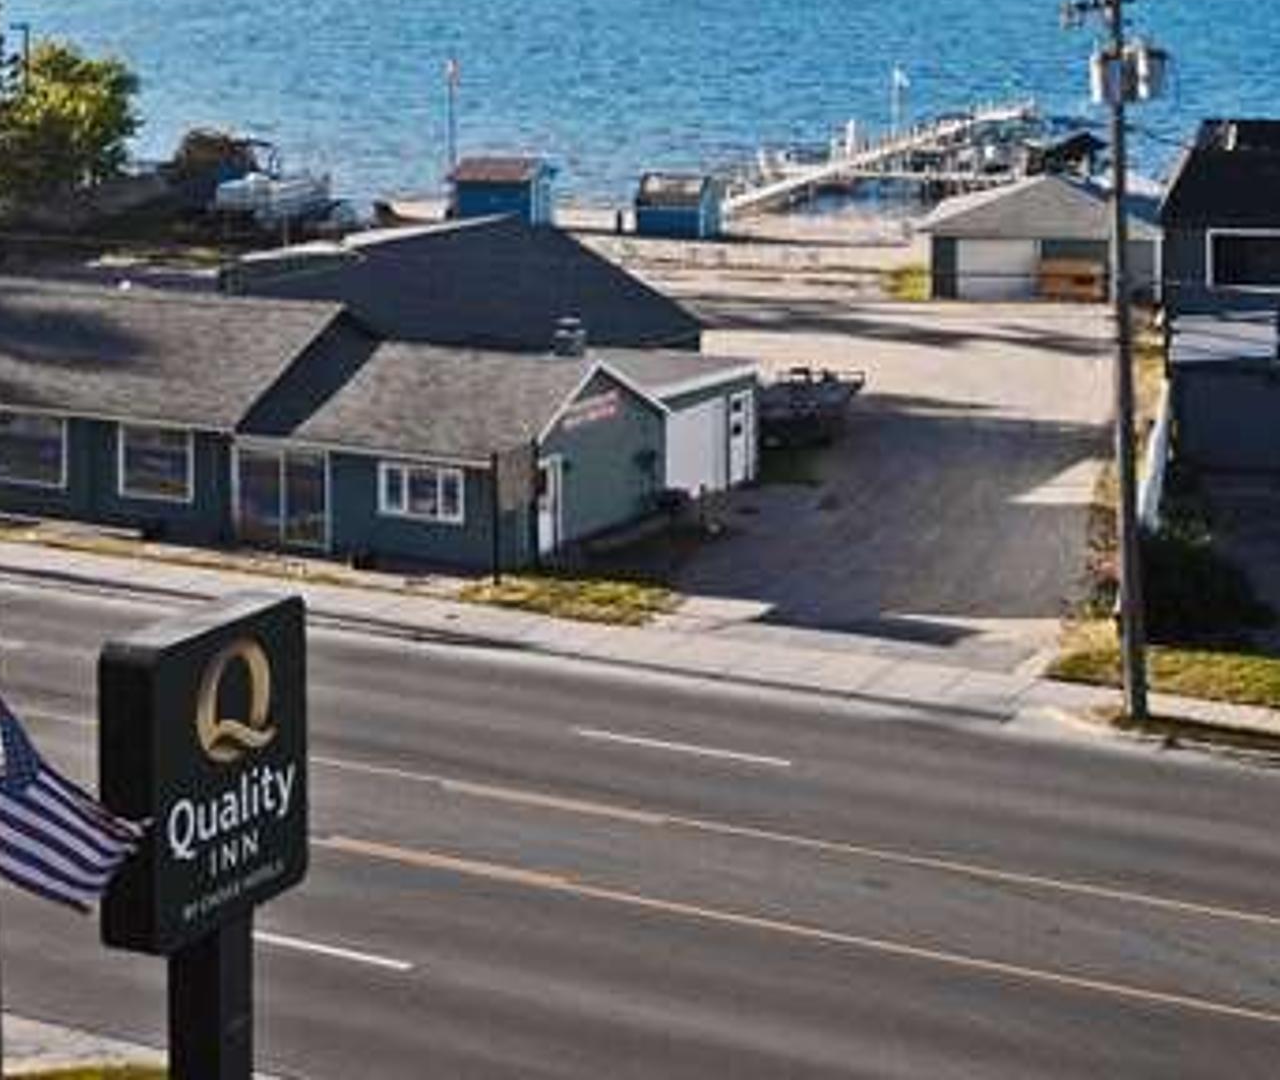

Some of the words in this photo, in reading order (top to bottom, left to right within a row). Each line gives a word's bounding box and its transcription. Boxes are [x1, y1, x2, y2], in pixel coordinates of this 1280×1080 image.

[196, 637, 277, 762] Q
[169, 764, 296, 860] Quality
[210, 829, 259, 877] INN
